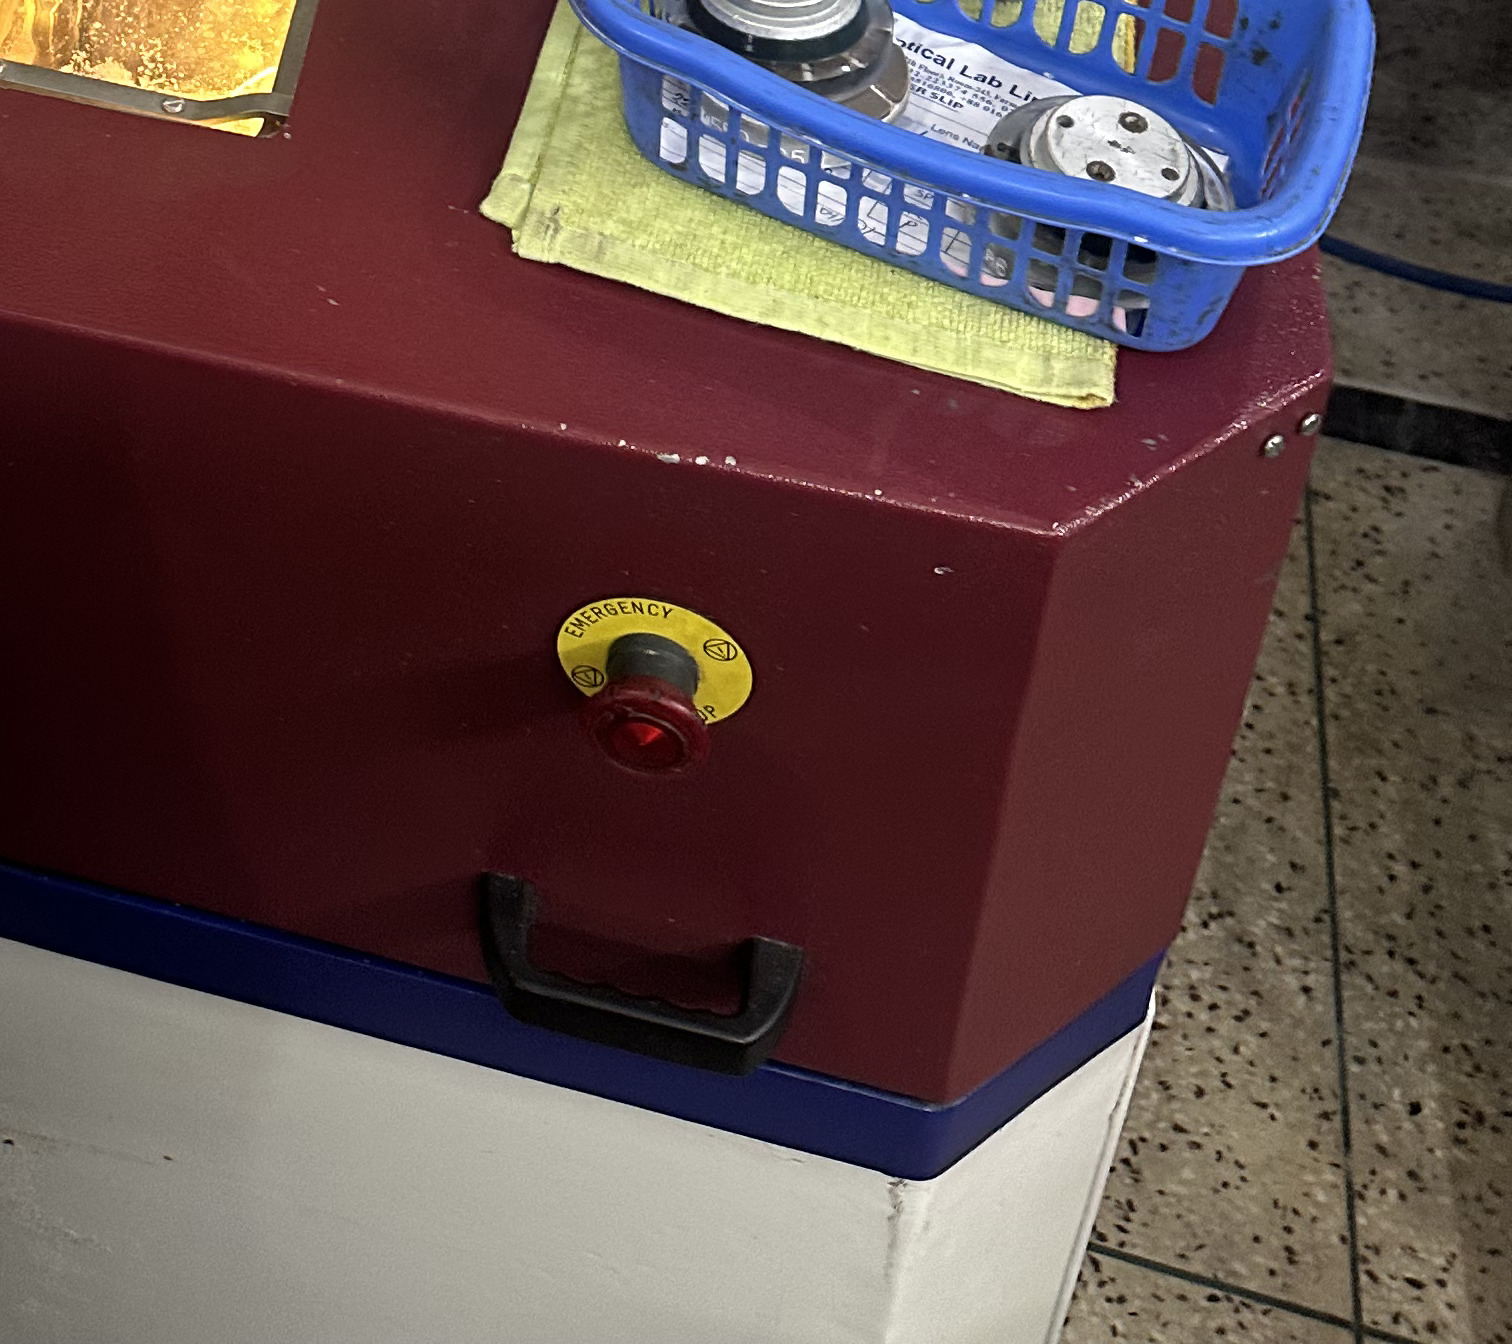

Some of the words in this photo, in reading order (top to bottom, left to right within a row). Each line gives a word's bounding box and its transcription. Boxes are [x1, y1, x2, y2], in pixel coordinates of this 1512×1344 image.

[959, 64, 1003, 90] Lab
[928, 89, 965, 111] SLIP
[930, 123, 961, 144] Lens
[563, 600, 674, 639] EMERGENCY
